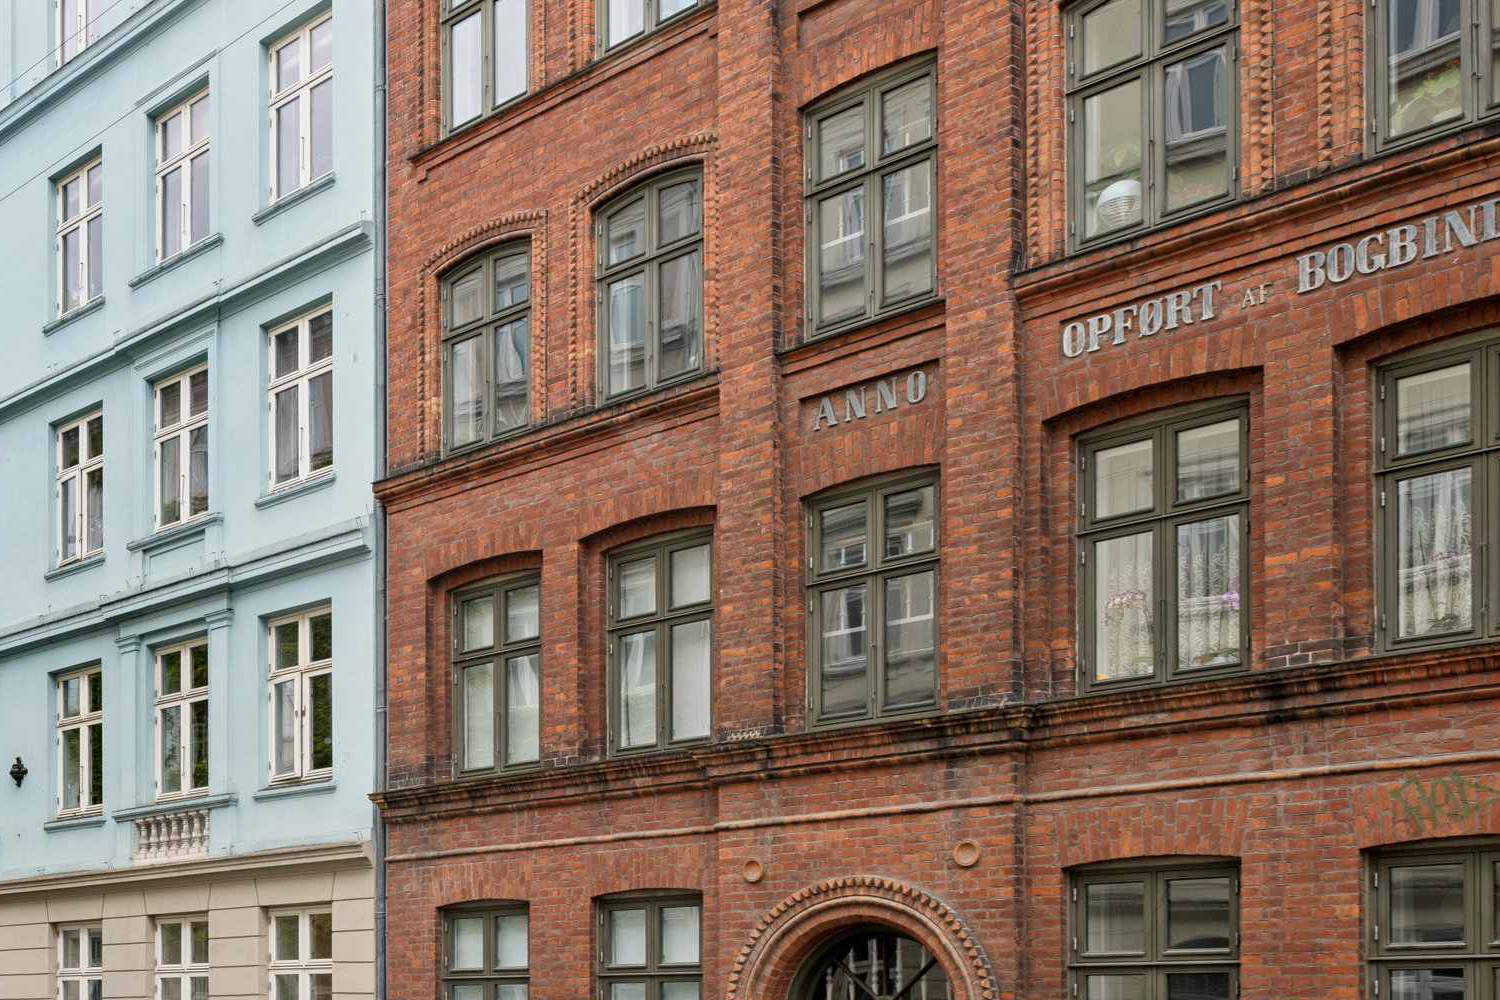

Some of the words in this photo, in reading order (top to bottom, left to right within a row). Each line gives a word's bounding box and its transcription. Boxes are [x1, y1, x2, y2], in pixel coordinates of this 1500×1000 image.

[1062, 280, 1222, 358] OPFØRT
[1241, 283, 1275, 309] AF
[813, 370, 927, 431] ANNO
